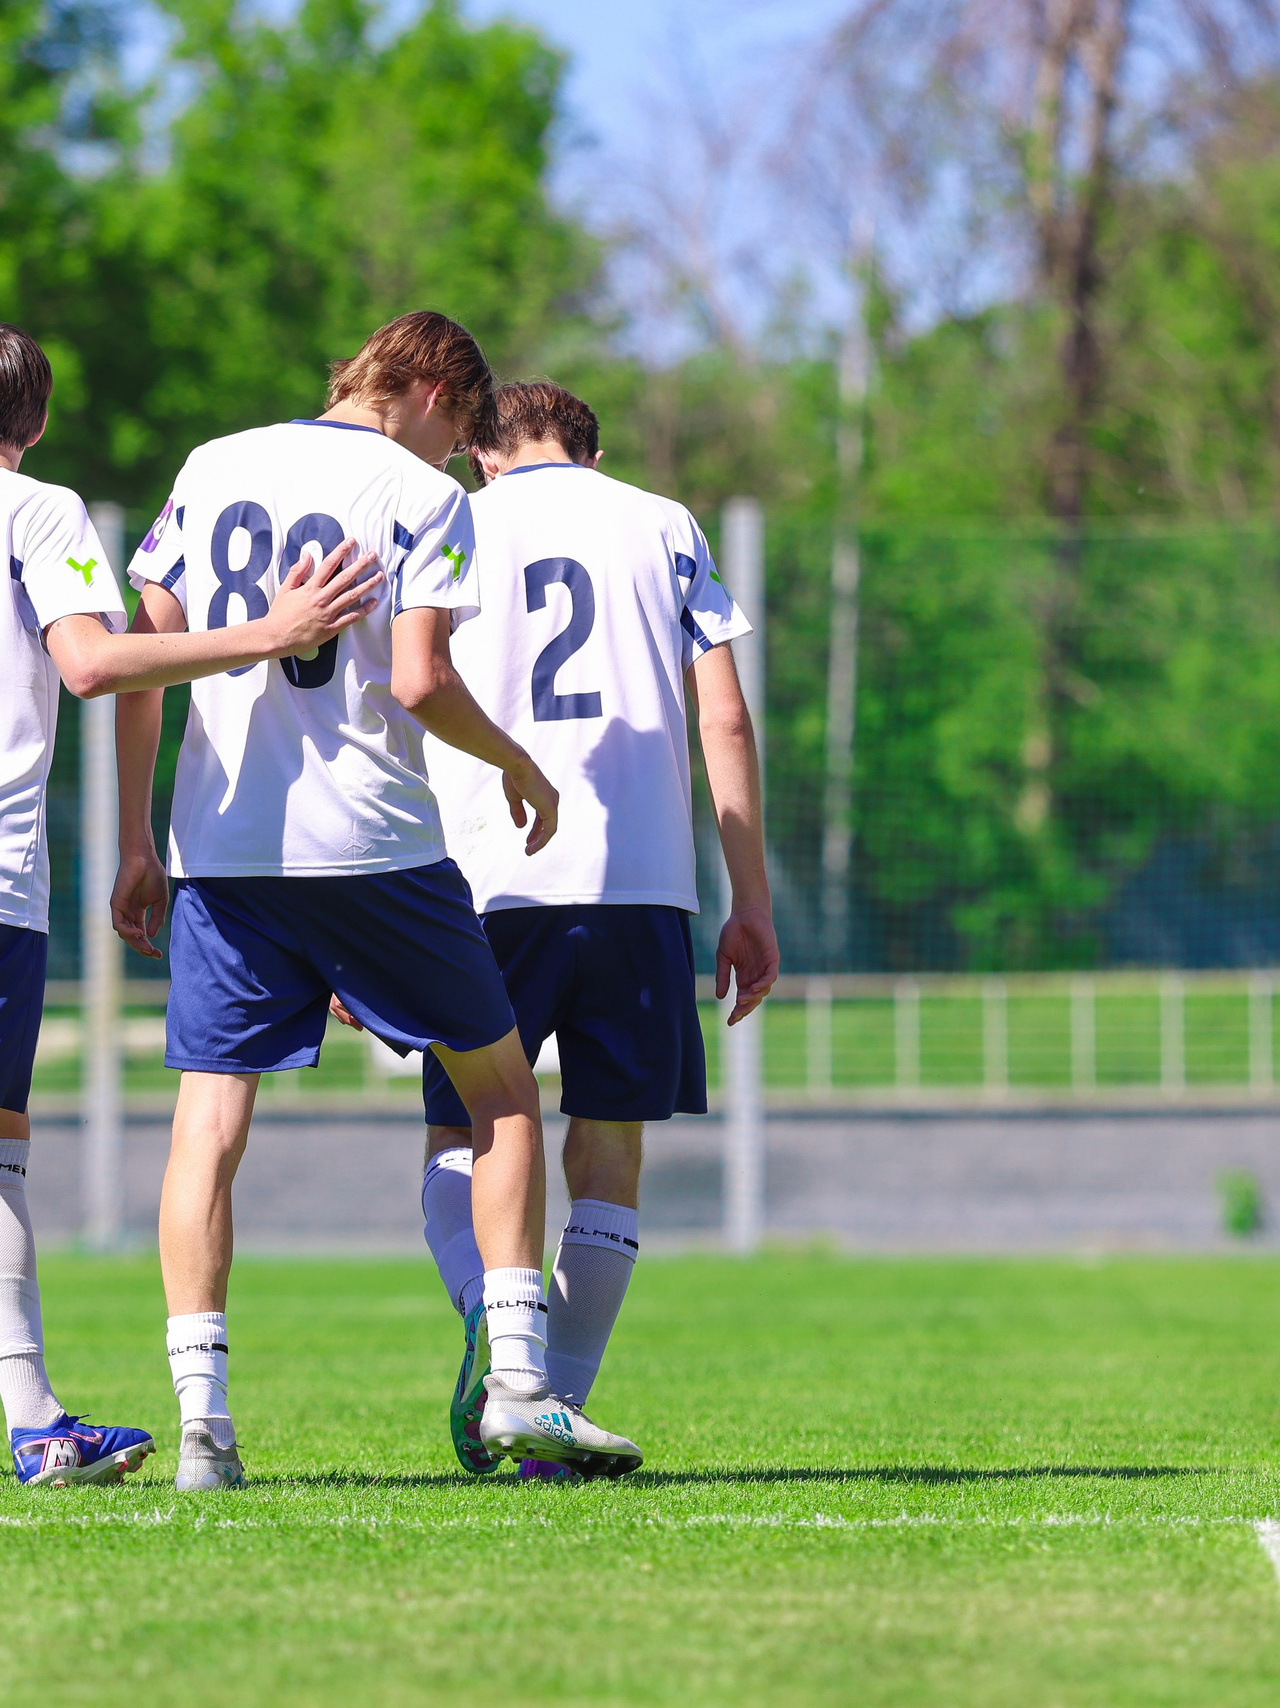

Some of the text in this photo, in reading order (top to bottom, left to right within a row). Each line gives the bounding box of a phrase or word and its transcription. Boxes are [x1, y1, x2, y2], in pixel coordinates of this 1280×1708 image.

[524, 557, 603, 722] 2
[487, 1300, 536, 1312] KELME
[534, 1416, 578, 1447] adidas
